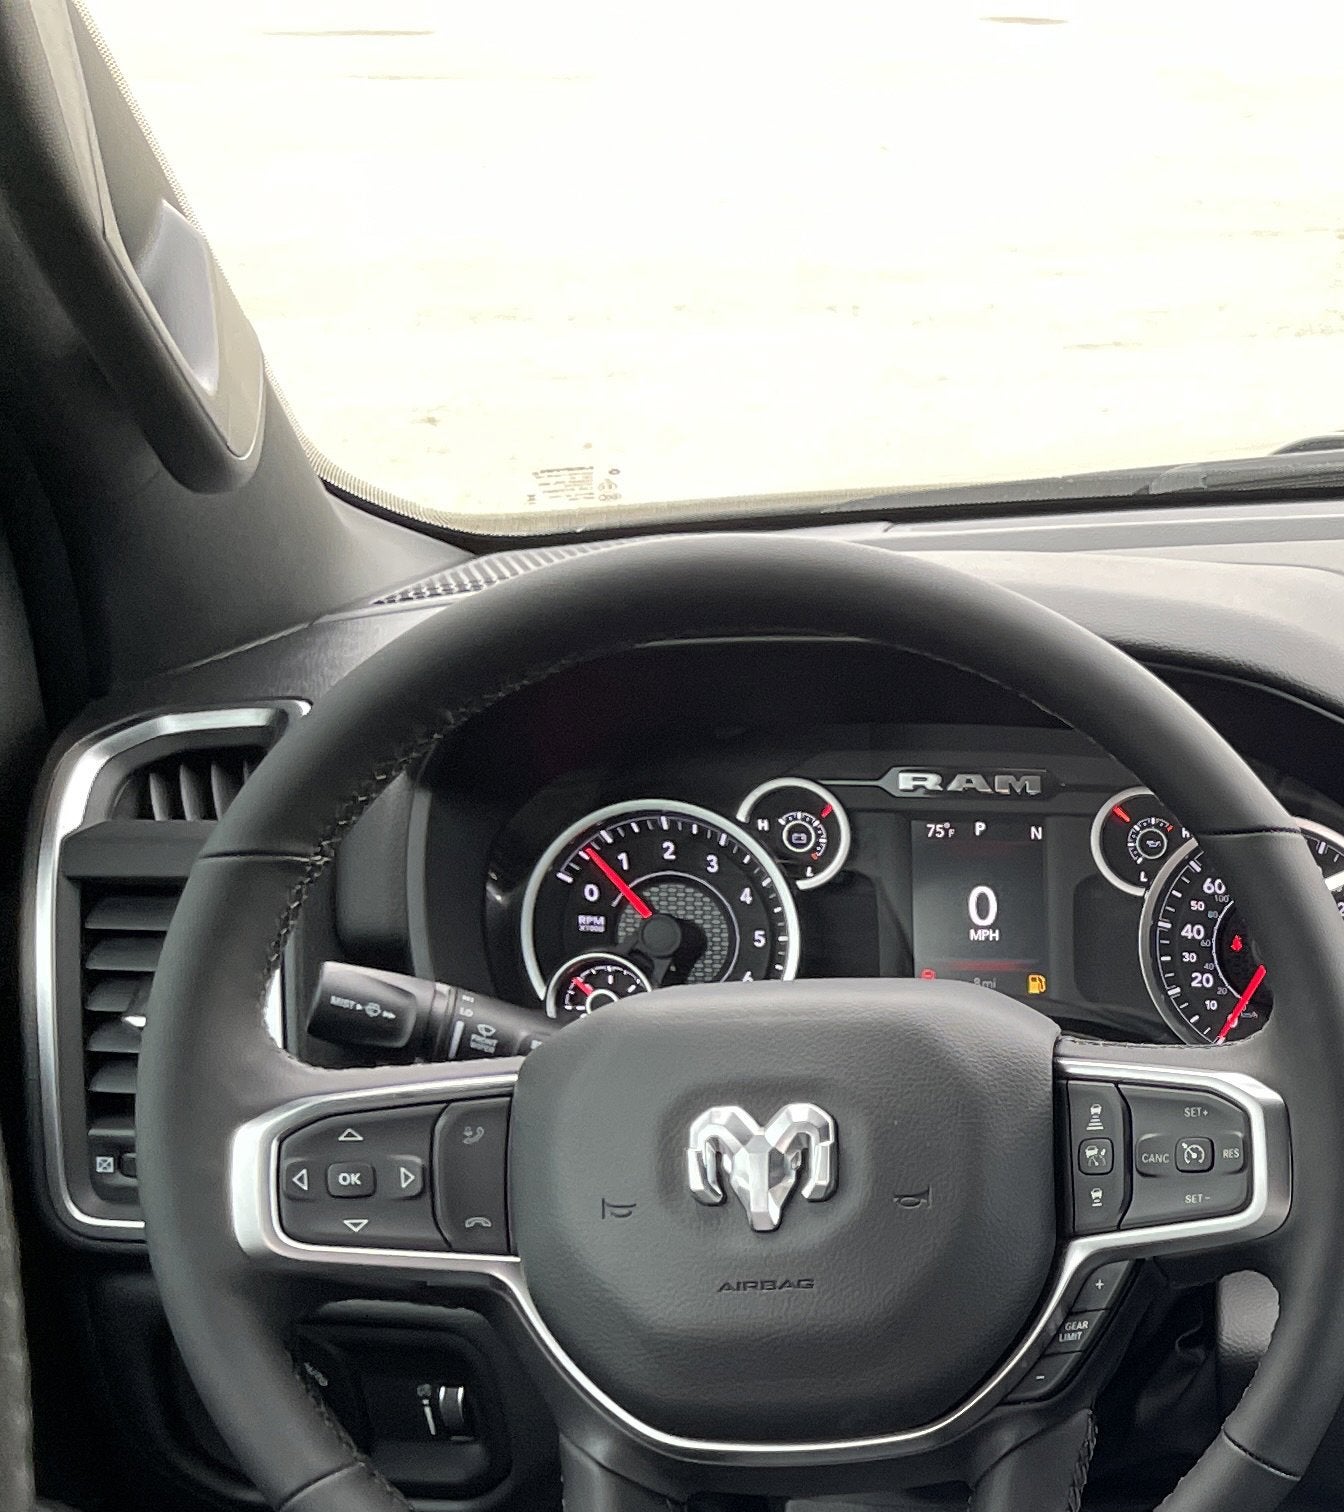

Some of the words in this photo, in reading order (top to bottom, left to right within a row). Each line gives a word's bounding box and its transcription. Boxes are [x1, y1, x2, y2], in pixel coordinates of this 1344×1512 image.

[898, 772, 1042, 796] RAM
[974, 822, 986, 836] P
[1030, 826, 1043, 840] N
[662, 841, 676, 860] 2
[617, 853, 629, 870] 1
[706, 854, 719, 873] 3
[583, 884, 600, 902] 0
[1203, 878, 1226, 894] 60
[740, 887, 752, 904] 4
[968, 885, 998, 926] 0
[1190, 900, 1205, 911] 50
[578, 915, 605, 926] RPM
[753, 930, 766, 948] 5
[970, 928, 999, 941] MPH
[1181, 924, 1205, 940] 40
[1182, 951, 1197, 963] 30
[1191, 972, 1213, 988] 20
[1205, 1000, 1218, 1011] 10
[1142, 1153, 1170, 1163] CANC
[1222, 1148, 1240, 1159] RES
[338, 1172, 362, 1186] OK
[717, 1278, 815, 1293] AIRBAG
[1064, 1320, 1088, 1331] GEAR
[1059, 1331, 1083, 1342] LIMIT
